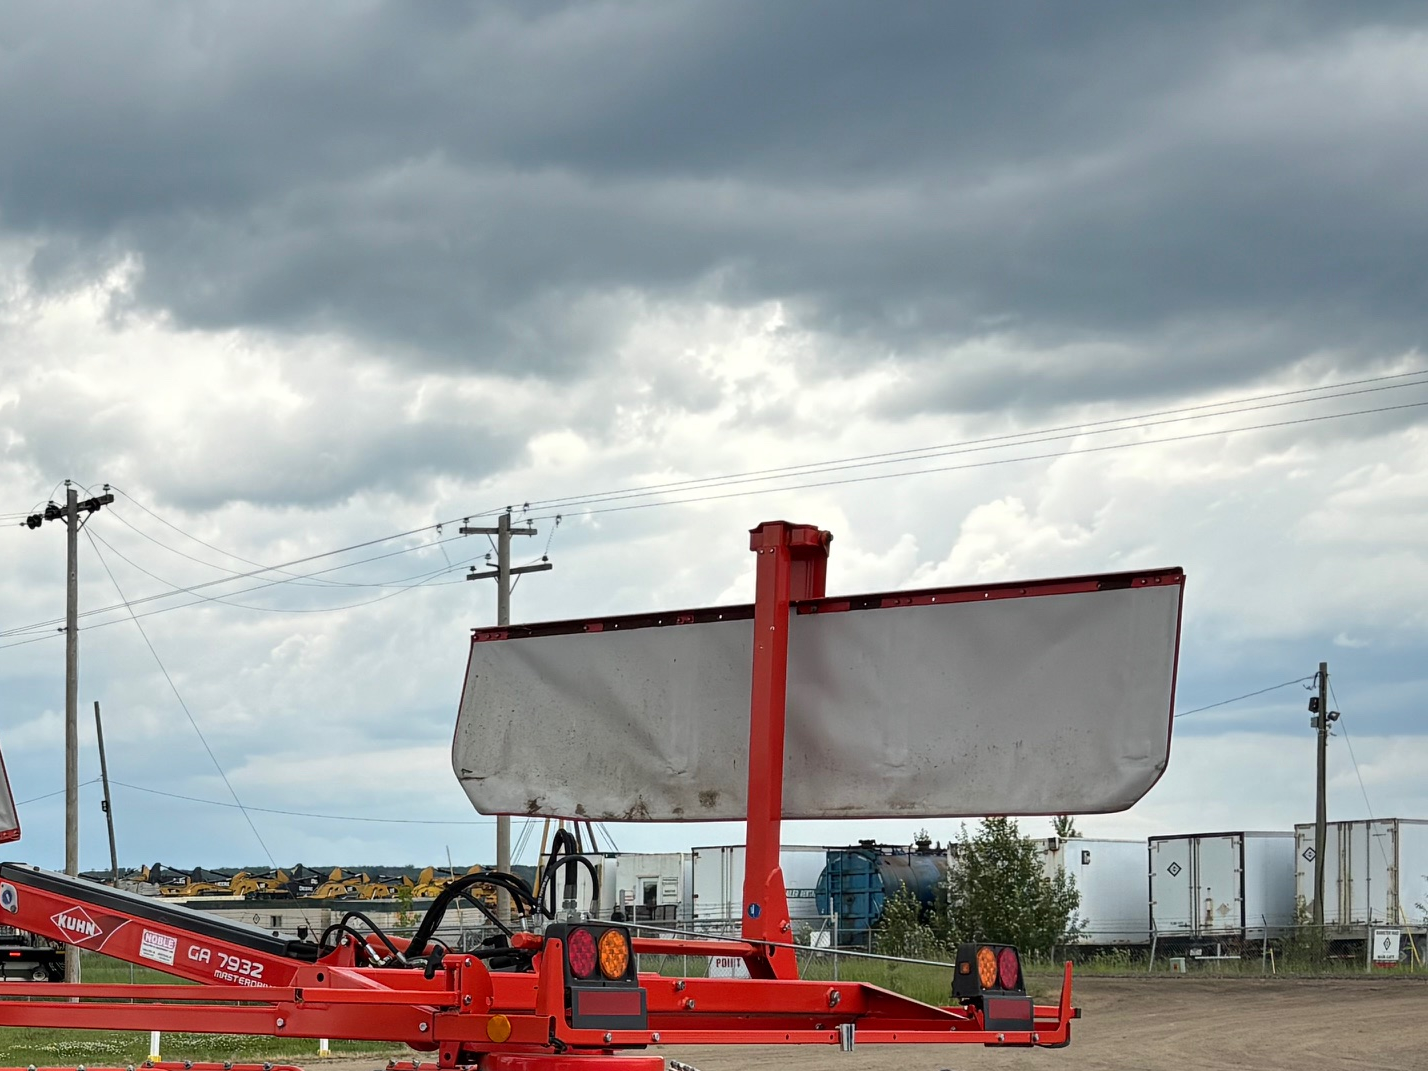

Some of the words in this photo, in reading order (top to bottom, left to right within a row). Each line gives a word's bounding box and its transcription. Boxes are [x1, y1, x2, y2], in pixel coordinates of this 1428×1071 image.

[57, 913, 96, 936] KUHN
[144, 931, 175, 949] NOBLE
[188, 945, 211, 964] GA
[217, 952, 264, 979] 7932
[716, 958, 741, 967] POINT
[214, 969, 275, 988] MASTERDR
